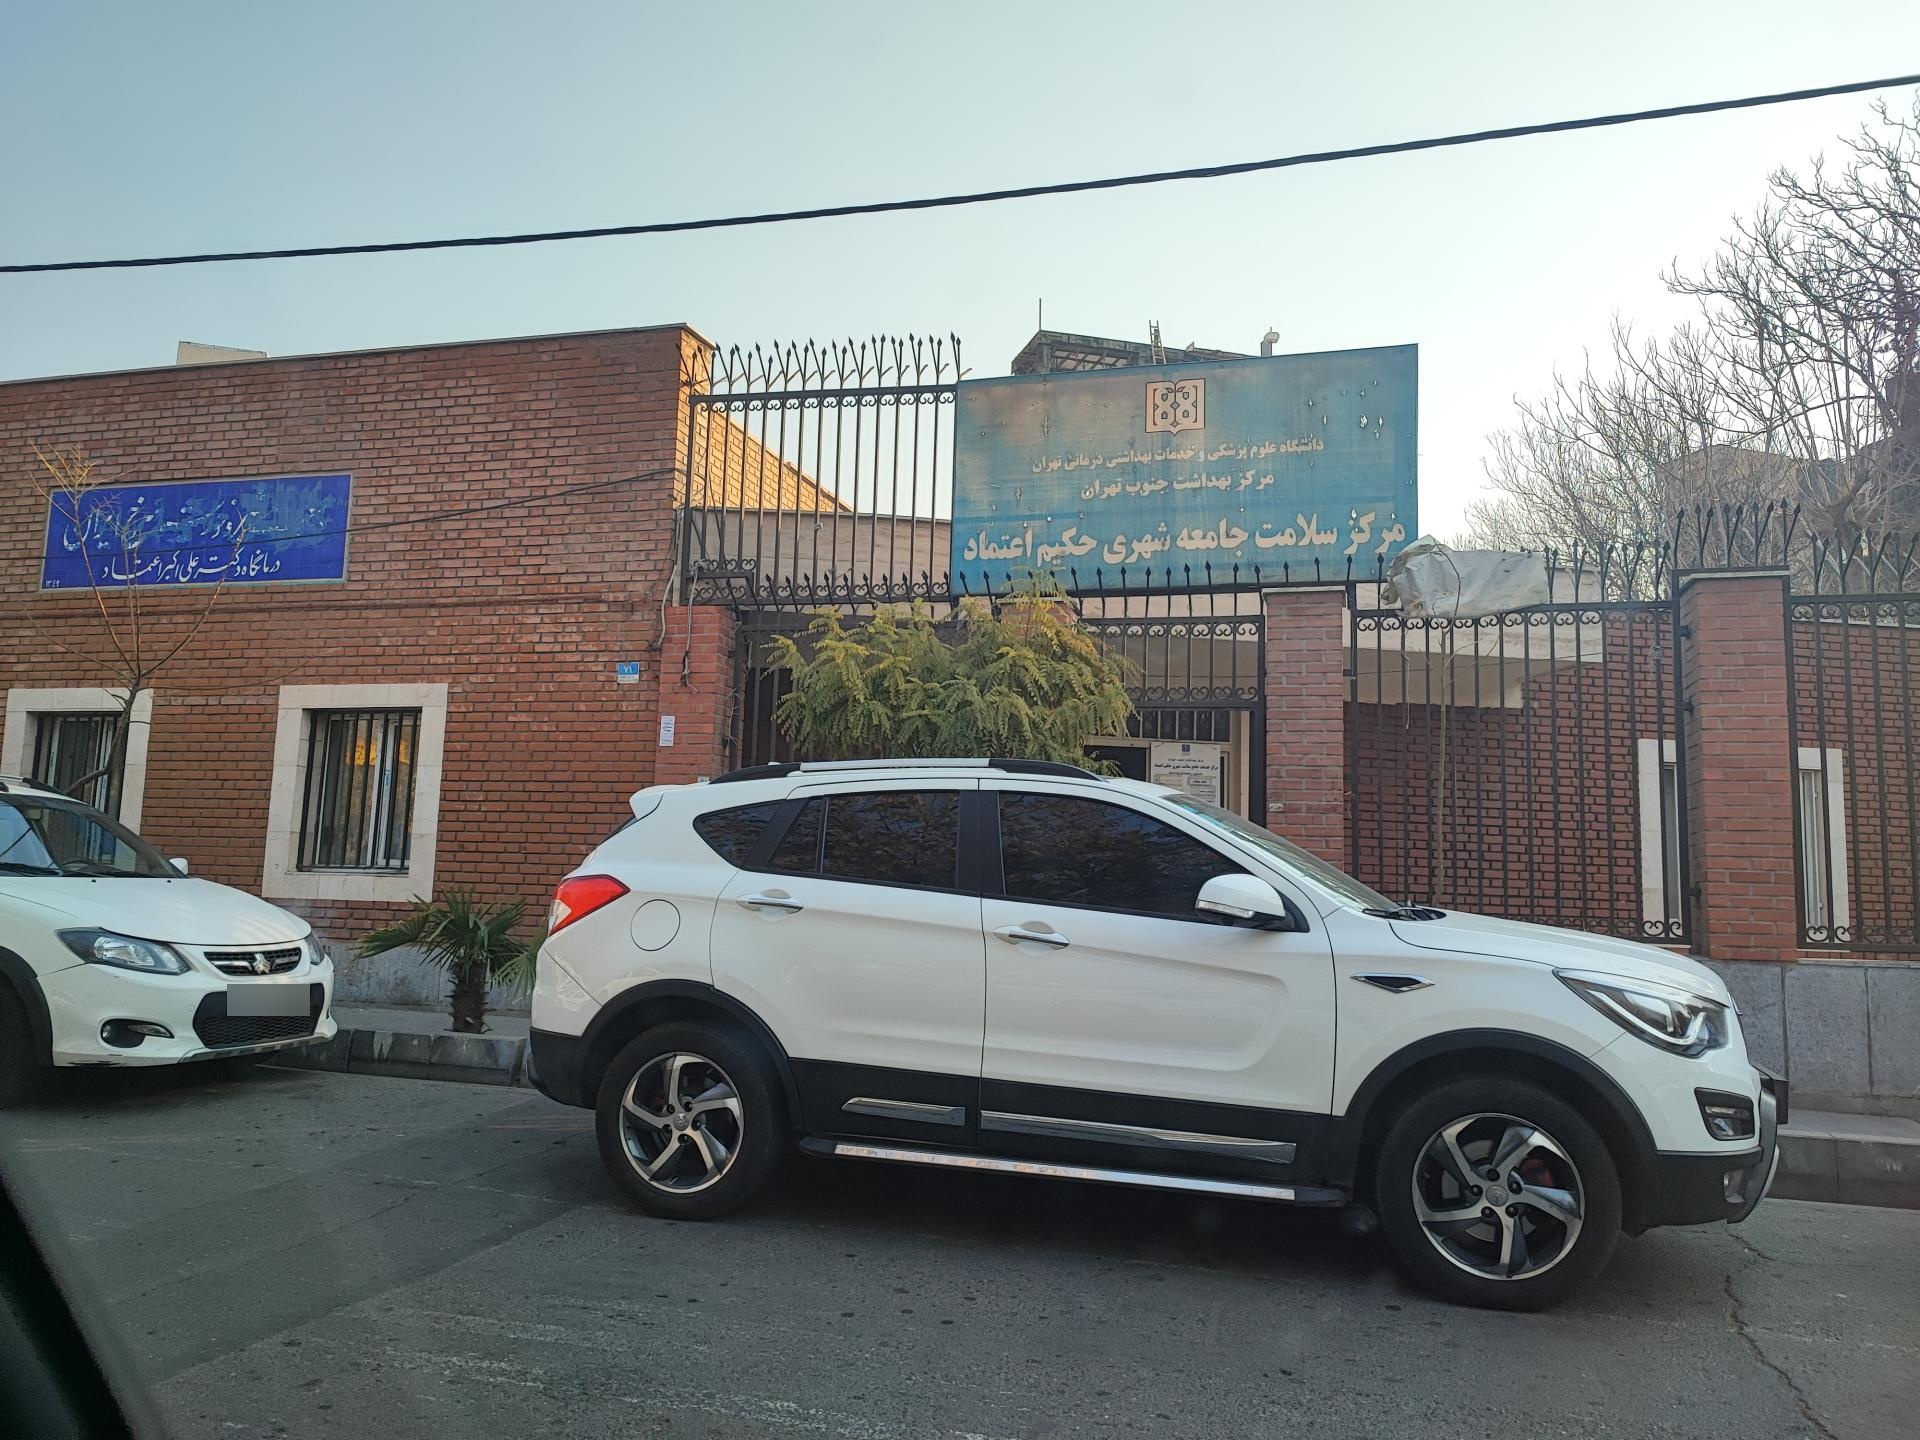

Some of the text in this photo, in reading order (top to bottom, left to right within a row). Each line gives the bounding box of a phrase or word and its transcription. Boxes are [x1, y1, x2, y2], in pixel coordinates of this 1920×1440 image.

[1032, 437, 1325, 473] دانشگاه علوم پزشکی و خدمات بهداشتی درمانی تهران
[1080, 469, 1274, 500] مرکز بهداشت جنوب تهران
[963, 511, 1406, 567] مرکز سلامت جامعه شهری حکیم اعتماد
[102, 546, 281, 583] درمانگاه دکتر علی اکبر اعتماد
